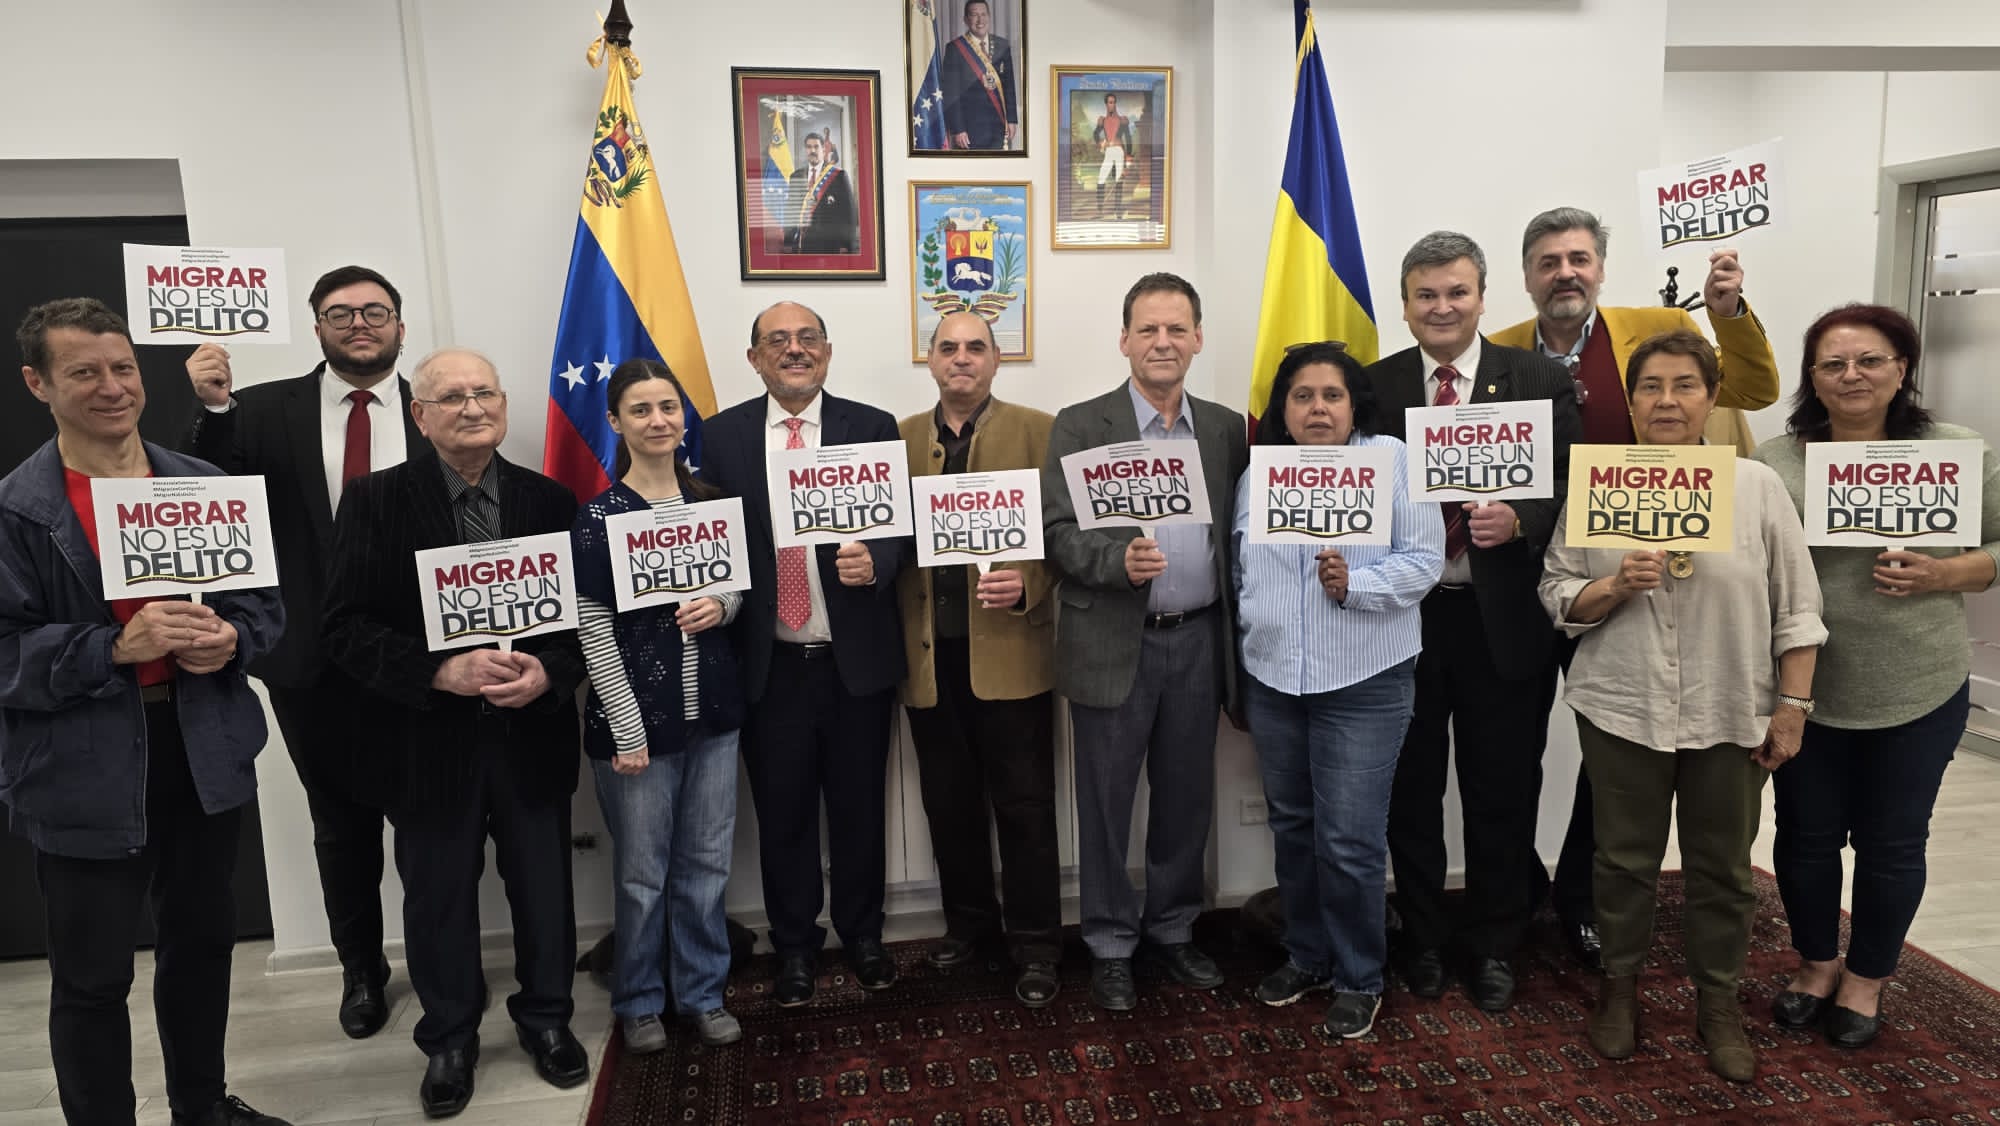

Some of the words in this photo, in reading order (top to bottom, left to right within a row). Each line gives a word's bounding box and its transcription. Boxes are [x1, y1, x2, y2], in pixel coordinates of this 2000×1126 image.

[1658, 163, 1766, 206] MIGRAR
[1659, 202, 1696, 224] NO
[1702, 194, 1728, 216] ES
[1735, 183, 1768, 207] UN
[1661, 204, 1769, 245] DELITO
[147, 265, 267, 288] MIGRAR
[149, 288, 189, 307] NO
[197, 288, 226, 307] ES
[233, 289, 268, 308] UN
[150, 308, 268, 331] DELITO
[1425, 422, 1533, 447] MIGRAR
[1426, 448, 1461, 466] NO
[1468, 446, 1494, 465] ES
[1500, 444, 1533, 464] UN
[789, 462, 890, 489] MIGRAR
[1082, 458, 1184, 484] MIGRAR
[1269, 467, 1375, 488] MIGRAR
[1426, 464, 1532, 488] DELITO
[1590, 466, 1713, 489] MIGRAR
[1828, 463, 1959, 485] MIGRAR
[791, 489, 826, 509] NO
[832, 487, 857, 506] ES
[862, 483, 893, 503] UN
[1088, 480, 1122, 499] NO
[1127, 478, 1152, 496] ES
[1157, 476, 1189, 494] UN
[1268, 489, 1304, 508] NO
[1311, 489, 1336, 508] ES
[1343, 489, 1374, 508] UN
[1828, 486, 1871, 506] NO
[1880, 486, 1911, 506] ES
[1919, 486, 1958, 507] UN
[930, 489, 1024, 513] MIGRAR
[1091, 494, 1191, 515] DELITO
[1589, 489, 1629, 509] NO
[1637, 490, 1666, 511] ES
[1674, 491, 1712, 512] UN
[117, 500, 248, 528] MIGRAR
[793, 503, 893, 530] DELITO
[932, 513, 963, 531] NO
[969, 512, 992, 529] ES
[998, 509, 1025, 527] UN
[1268, 509, 1372, 532] DELITO
[1588, 511, 1709, 536] DELITO
[1828, 507, 1957, 531] DELITO
[120, 529, 166, 553] NO
[174, 527, 207, 550] ES
[213, 525, 251, 547] UN
[626, 520, 728, 553] MIGRAR
[933, 528, 1025, 551] DELITO
[123, 548, 253, 581] DELITO
[629, 551, 664, 573] NO
[670, 546, 695, 566] ES
[701, 540, 730, 560] UN
[435, 553, 557, 590] MIGRAR
[632, 560, 731, 594] DELITO
[438, 588, 481, 613] NO
[488, 582, 519, 605] ES
[525, 575, 560, 599] UN
[441, 598, 562, 636] DELITO
